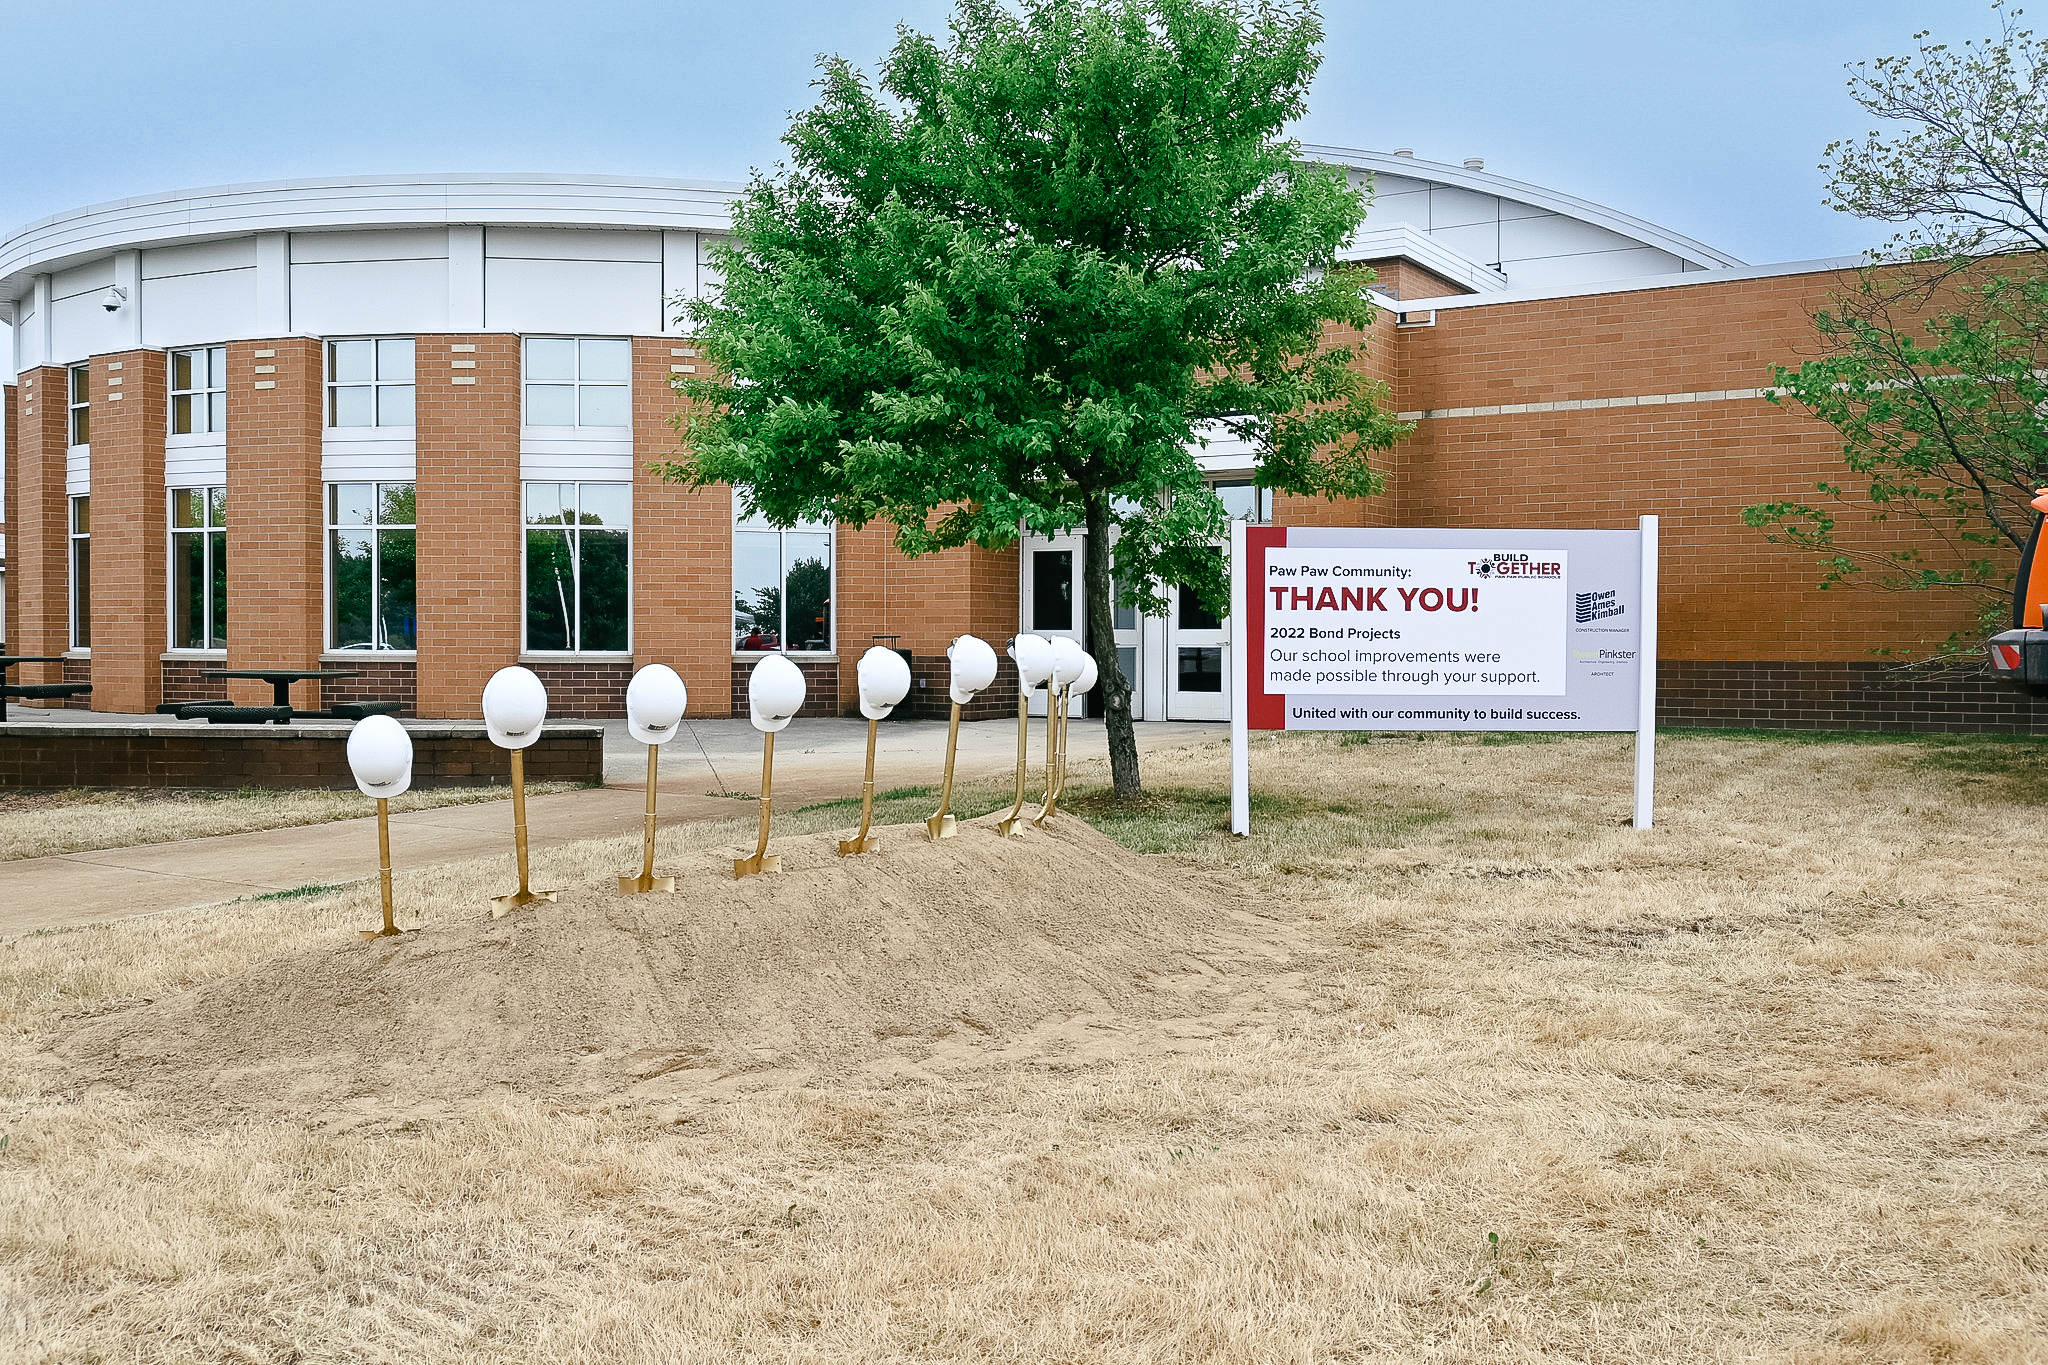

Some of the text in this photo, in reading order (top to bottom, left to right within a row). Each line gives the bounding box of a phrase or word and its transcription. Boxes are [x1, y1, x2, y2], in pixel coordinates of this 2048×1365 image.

[1493, 553, 1529, 562] BUILD
[1269, 565, 1412, 580] Paw Paw Community:
[1467, 561, 1561, 575] TOGETHER
[1269, 586, 1479, 613] THANK YOU!
[1591, 589, 1616, 602] Owen
[1591, 599, 1616, 611] Ames
[1591, 604, 1625, 621] Kimball
[1270, 627, 1401, 642] 2022 Bond Projects
[1270, 648, 1501, 665] Our school improvements were
[1270, 669, 1541, 686] made possible through your support.
[1292, 706, 1582, 722] United with our community to build success.
